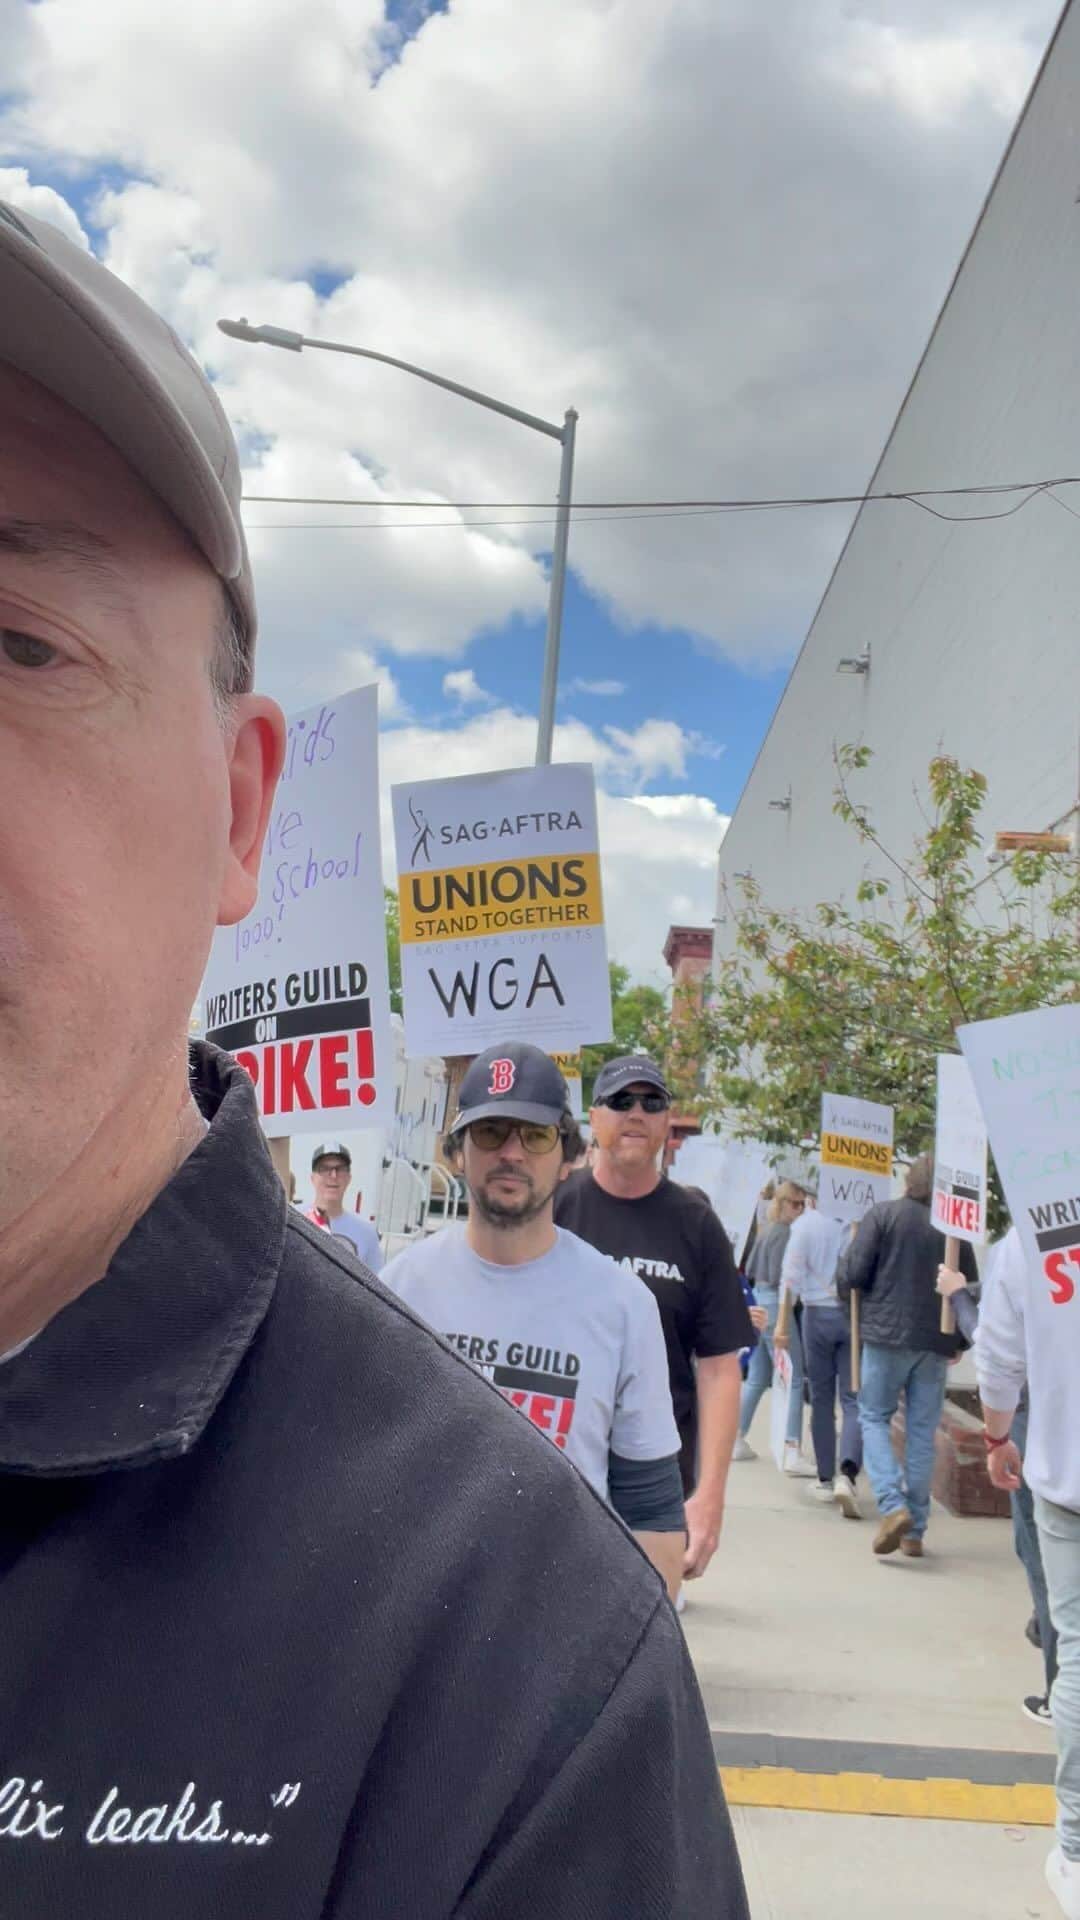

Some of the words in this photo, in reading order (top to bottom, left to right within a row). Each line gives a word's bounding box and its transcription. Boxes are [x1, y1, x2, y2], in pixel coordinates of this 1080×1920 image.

[280, 706, 337, 781] ids
[412, 860, 588, 914] UNIONS
[415, 914, 478, 937] STAND
[482, 903, 590, 929] TOGETHER
[206, 978, 277, 1029] WRITERS
[285, 962, 368, 1007] GUILD
[428, 953, 566, 1018] WGA
[255, 1016, 277, 1043] ON
[488, 1058, 516, 1095] B
[827, 1136, 889, 1163] UNIONS
[831, 1177, 876, 1208] WGA
[955, 1169, 980, 1188] GUILD
[506, 1342, 580, 1377] GUILD
